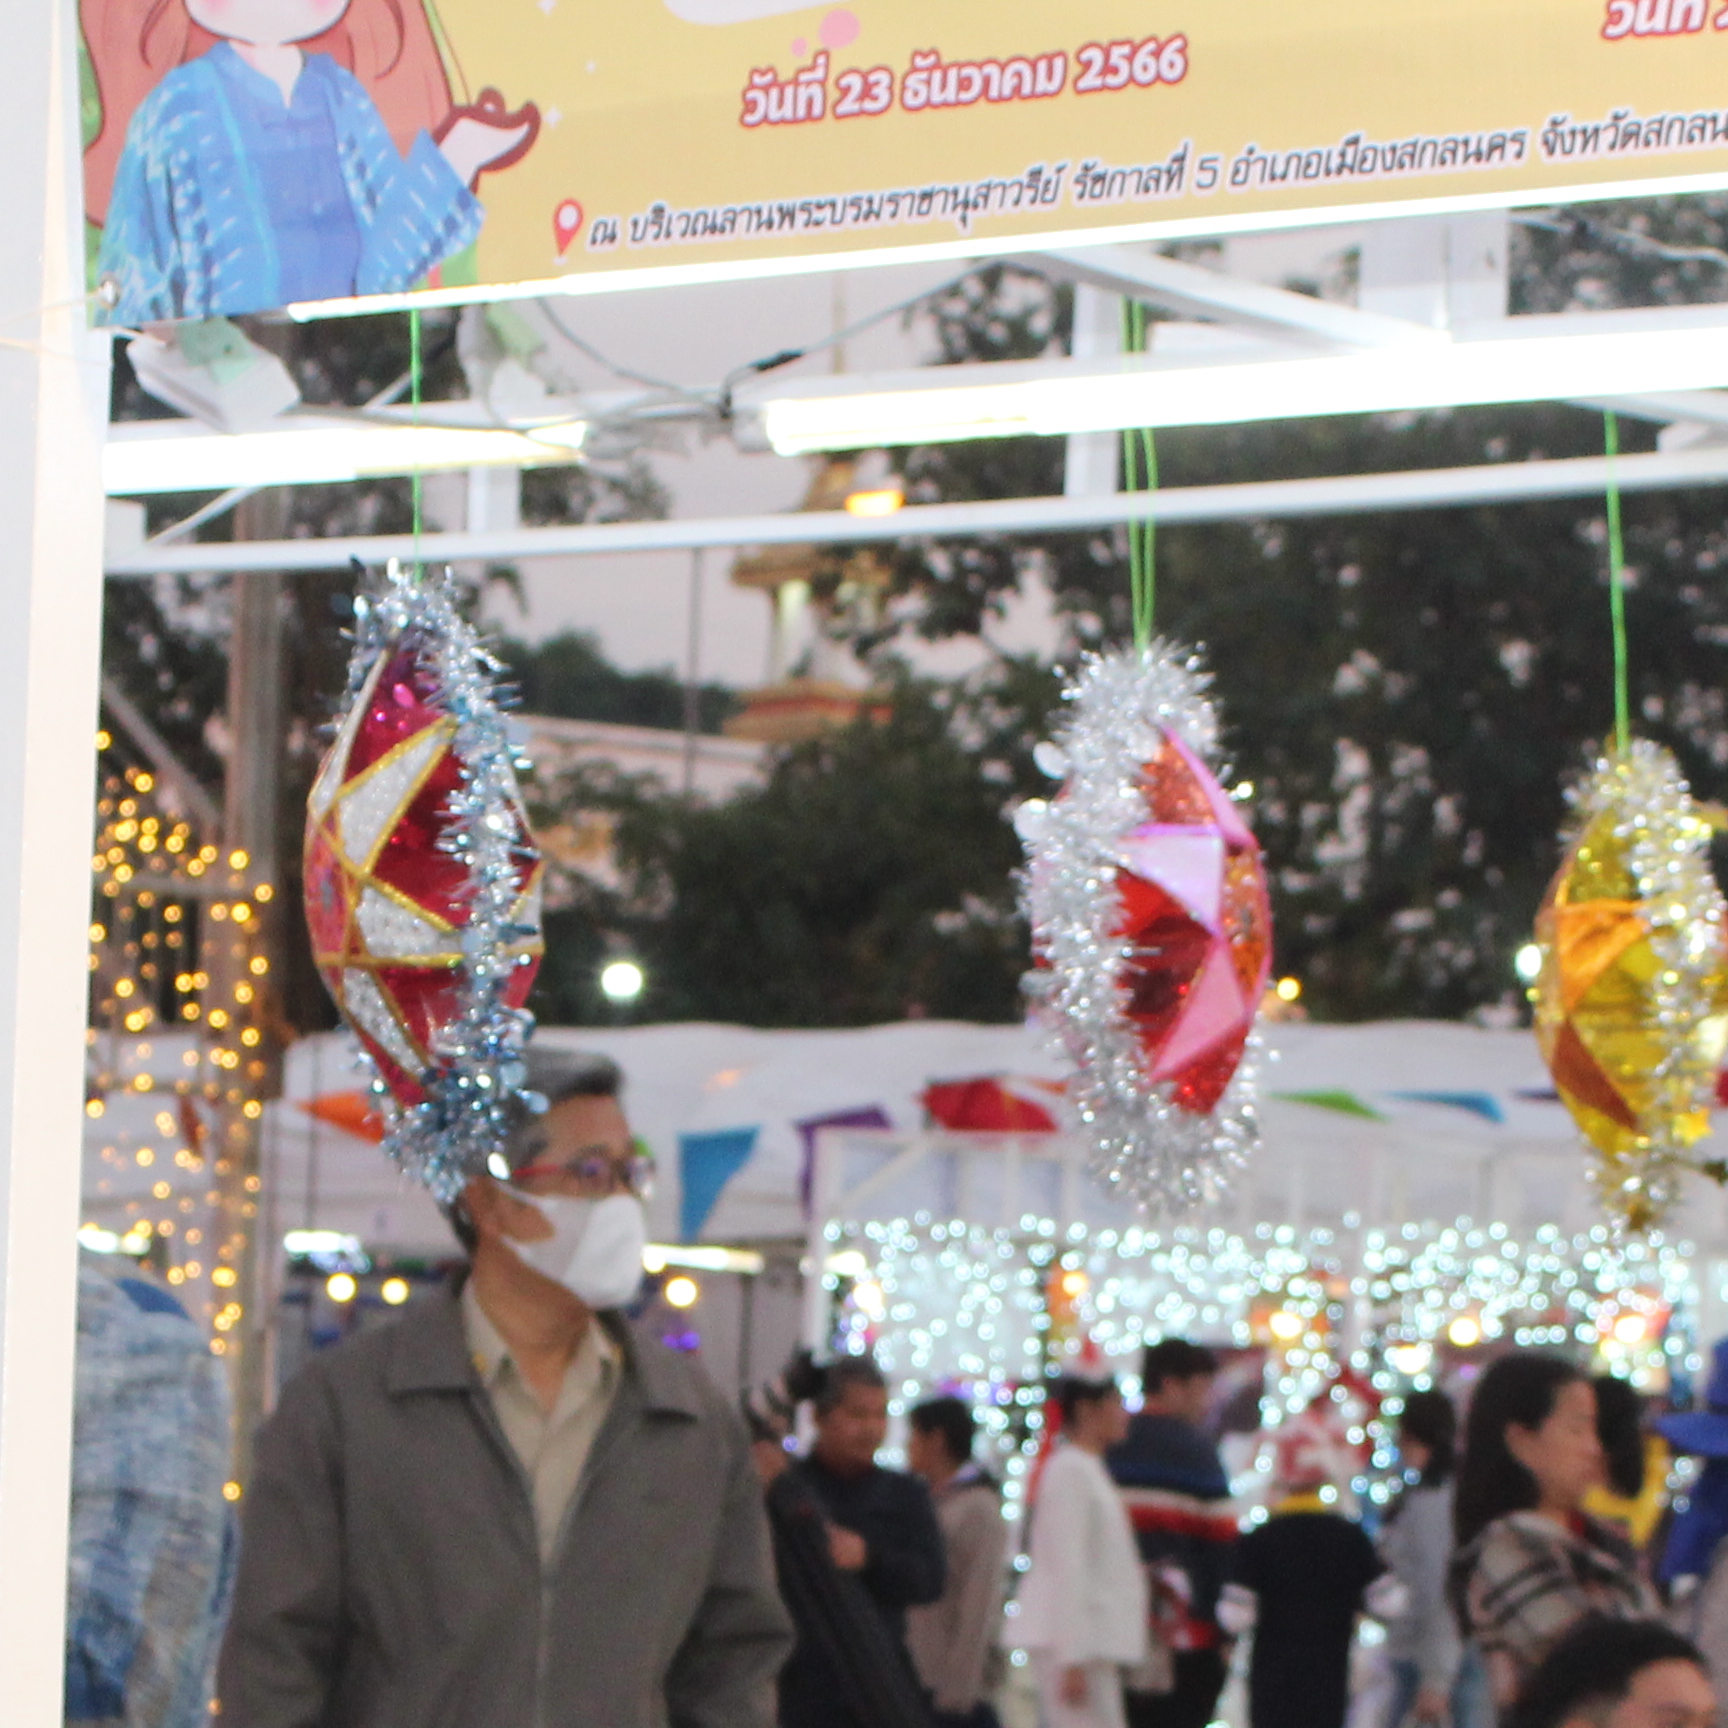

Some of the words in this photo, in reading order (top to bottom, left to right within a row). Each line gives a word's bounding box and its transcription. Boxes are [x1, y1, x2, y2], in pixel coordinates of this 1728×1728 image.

[742, 51, 828, 125] วันที่
[834, 67, 893, 116] 23
[902, 50, 1066, 108] ธันวาคม
[1075, 35, 1187, 92] 2566
[590, 216, 618, 247] ณ
[628, 163, 1069, 244] บริเวณลานพระบรมราชานุสาวรีย์
[1072, 143, 1189, 200] รัชกาลที่
[1195, 157, 1221, 189] 5
[1229, 130, 1528, 187] อำเภอเมืองสกลนคร
